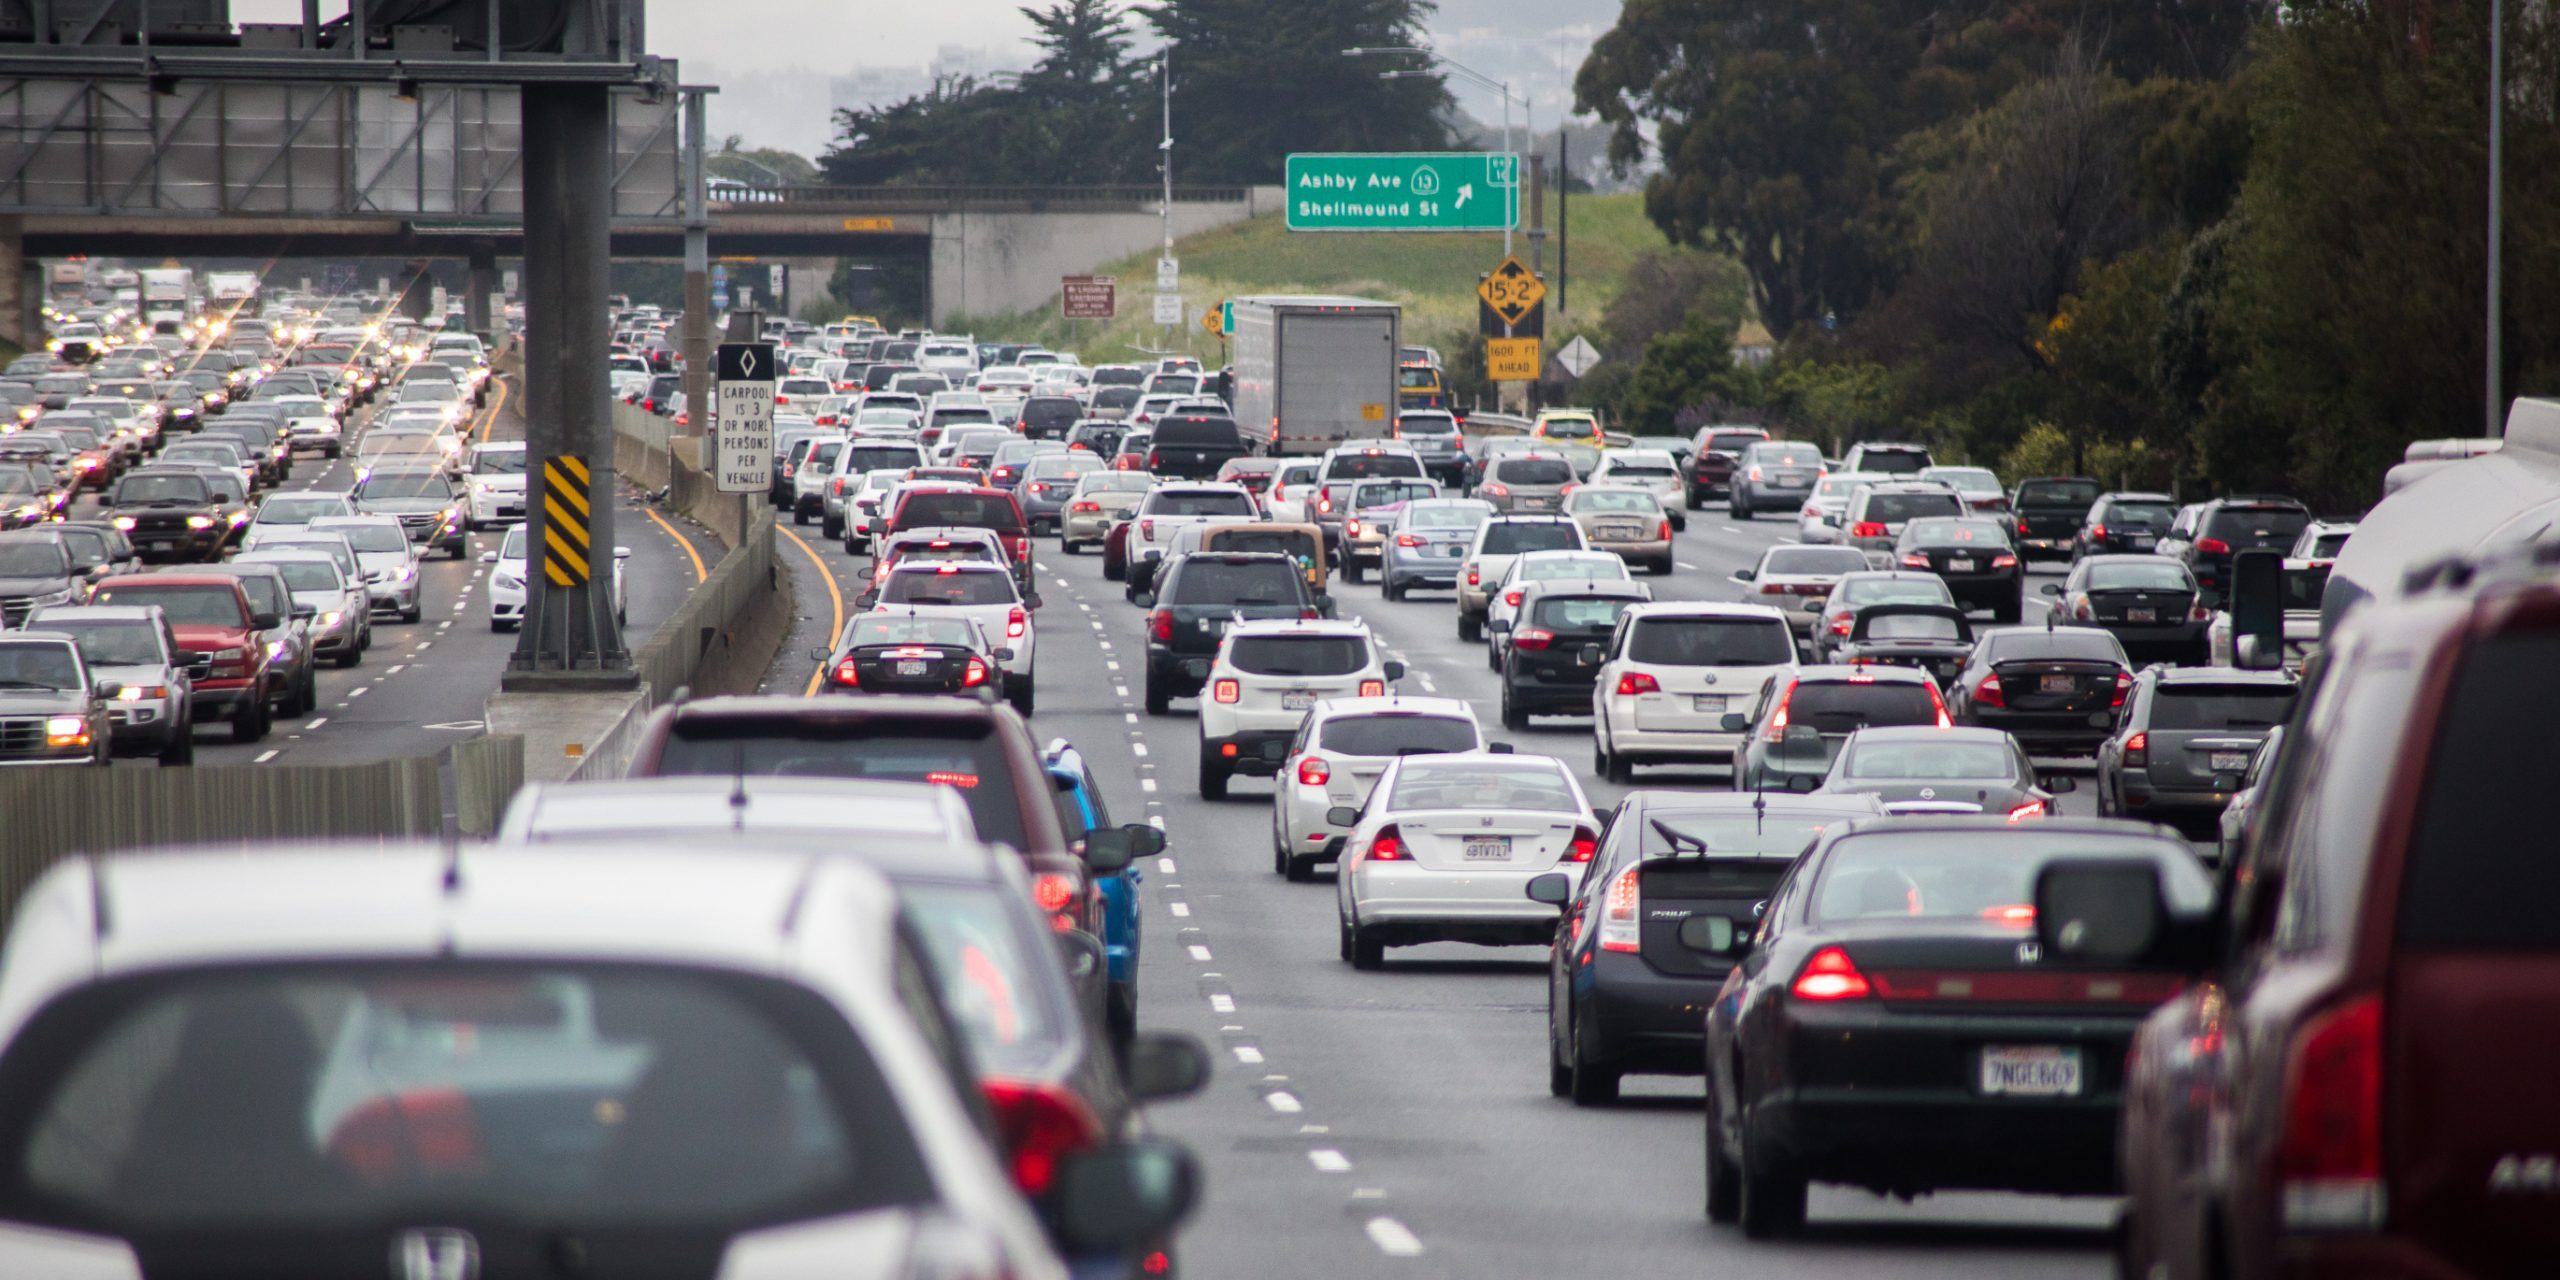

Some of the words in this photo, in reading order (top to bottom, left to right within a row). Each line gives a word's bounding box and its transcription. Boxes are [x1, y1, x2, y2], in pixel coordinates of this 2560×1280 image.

[1300, 172, 1357, 191] Ashby
[1368, 173, 1402, 188] Ave
[1418, 175, 1432, 189] 13
[1300, 201, 1410, 216] Shellmound
[1419, 201, 1439, 216] St
[1490, 346, 1513, 356] 1600
[1524, 346, 1537, 356] FT
[1498, 363, 1530, 373] AHEAD
[724, 387, 770, 399] CARPOOL
[735, 404, 745, 415] IS
[753, 402, 760, 415] 3
[724, 420, 738, 432] OR
[743, 420, 768, 432] MORE
[724, 437, 768, 449] PERSONS
[738, 455, 756, 467] PER
[726, 472, 765, 484] VEHICLE
